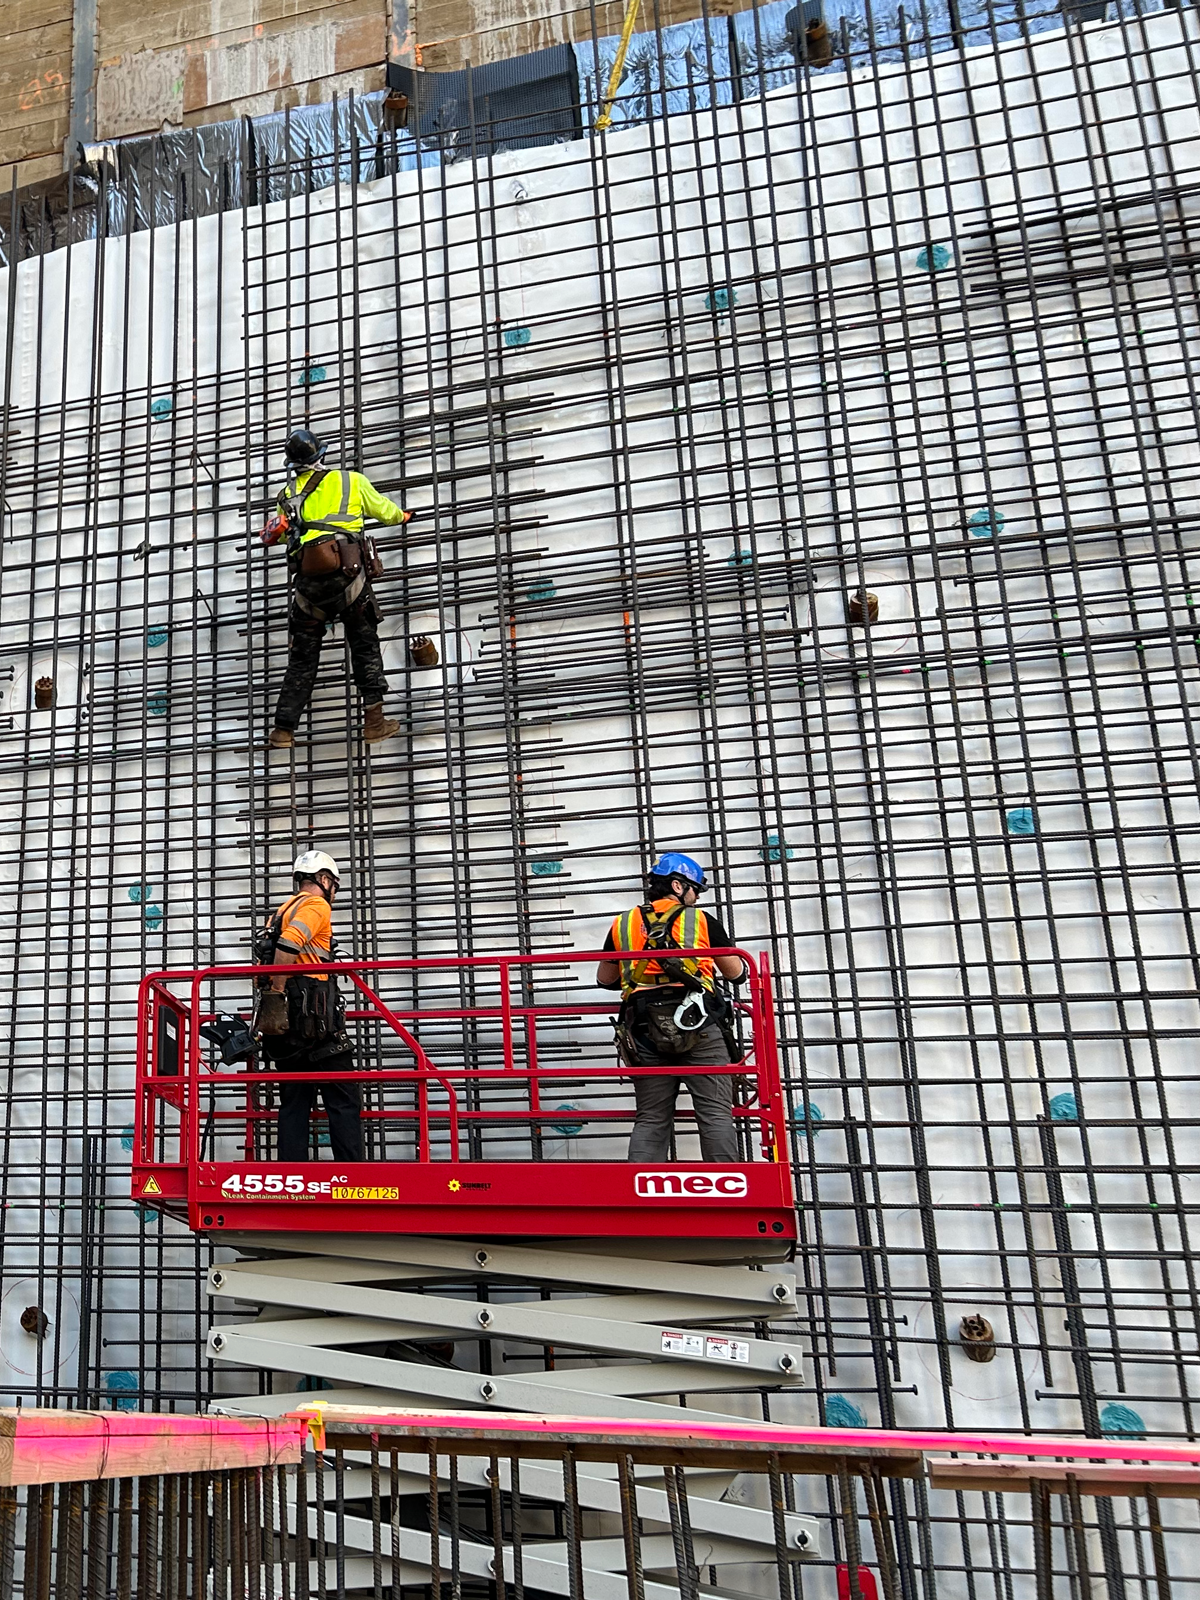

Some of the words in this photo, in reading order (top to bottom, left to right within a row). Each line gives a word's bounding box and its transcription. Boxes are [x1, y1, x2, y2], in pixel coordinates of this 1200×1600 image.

[221, 1174, 305, 1193] 4555
[307, 1182, 331, 1193] SE
[330, 1175, 348, 1183] AC
[637, 1175, 745, 1194] mec
[291, 1193, 316, 1201] System
[333, 1188, 398, 1199] 10767125
